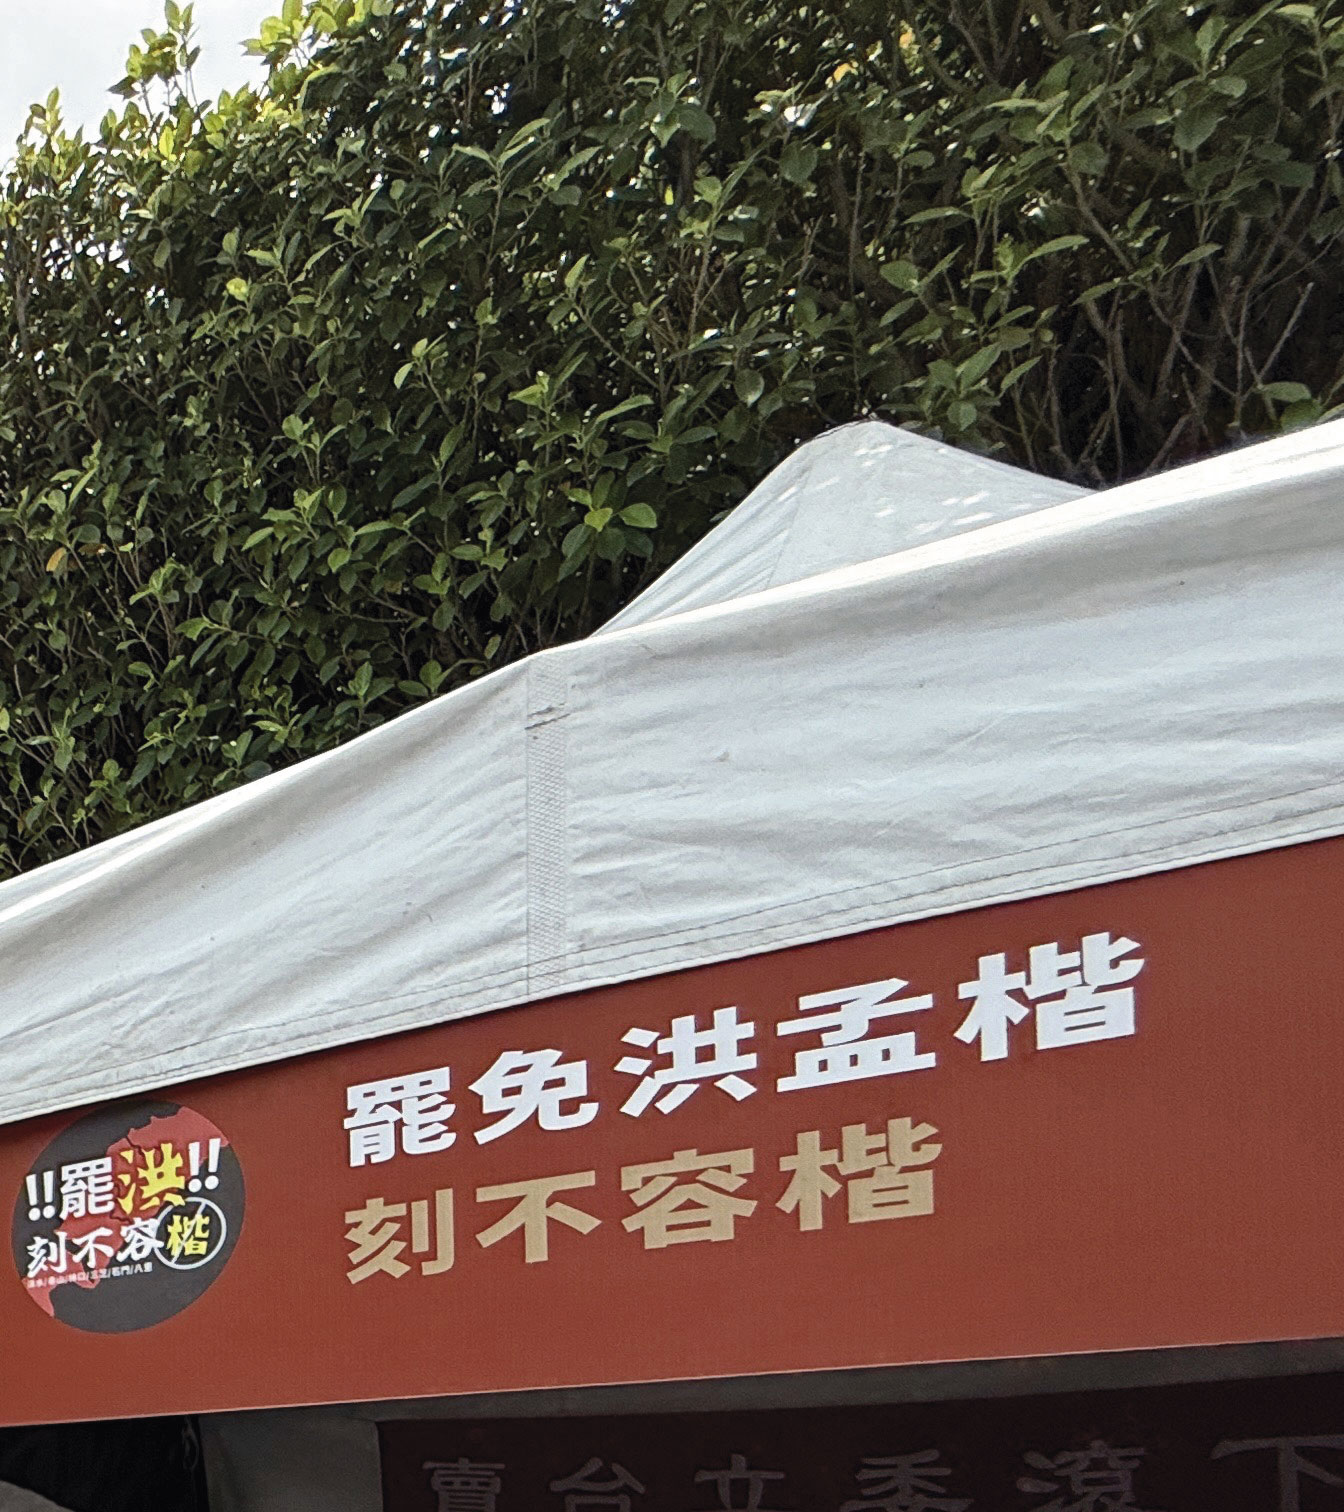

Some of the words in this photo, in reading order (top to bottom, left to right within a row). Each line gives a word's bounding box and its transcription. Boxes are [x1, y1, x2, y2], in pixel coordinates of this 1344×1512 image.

[343, 931, 1147, 1168] 罷免洪孟楷
[343, 1116, 945, 1286] 刻不容楷
